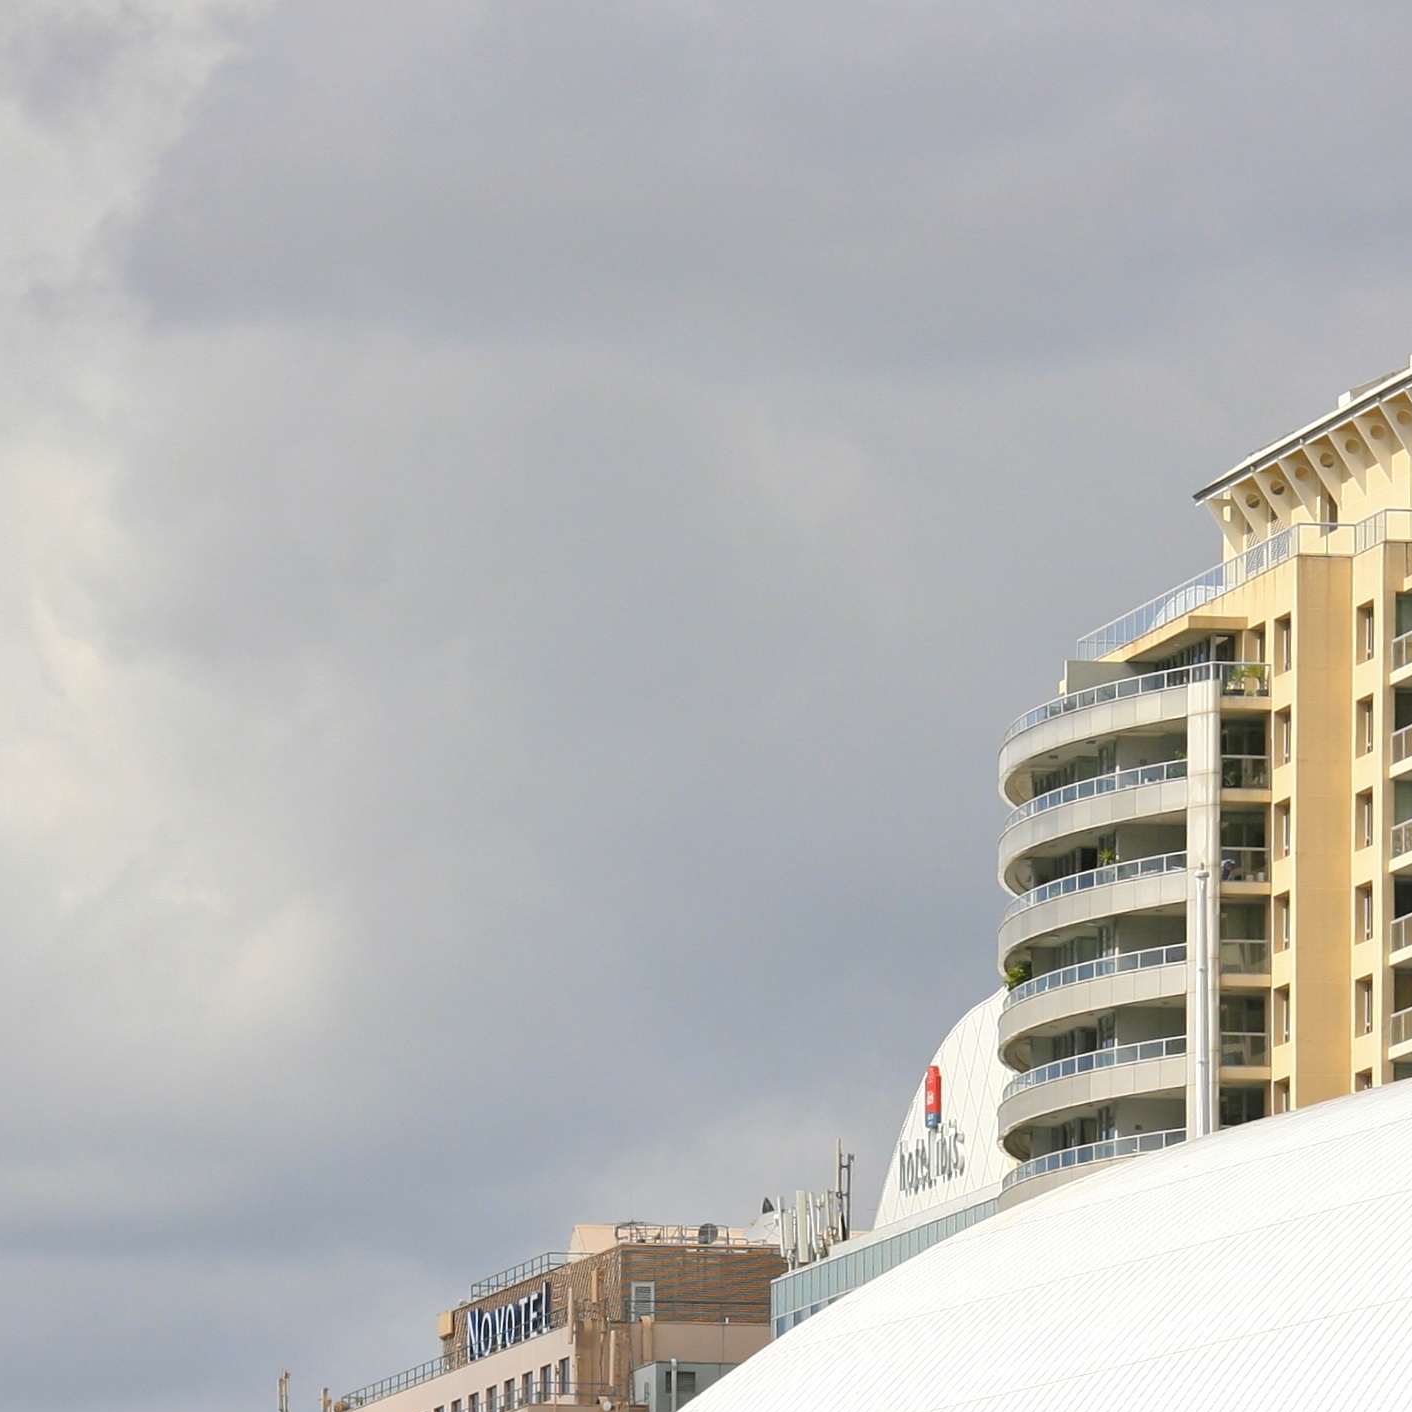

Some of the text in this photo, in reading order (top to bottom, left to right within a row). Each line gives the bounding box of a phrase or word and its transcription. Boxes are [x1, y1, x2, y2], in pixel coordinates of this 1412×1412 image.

[899, 1119, 965, 1191] hotel ibis
[467, 1282, 550, 1363] NOVOTEL
